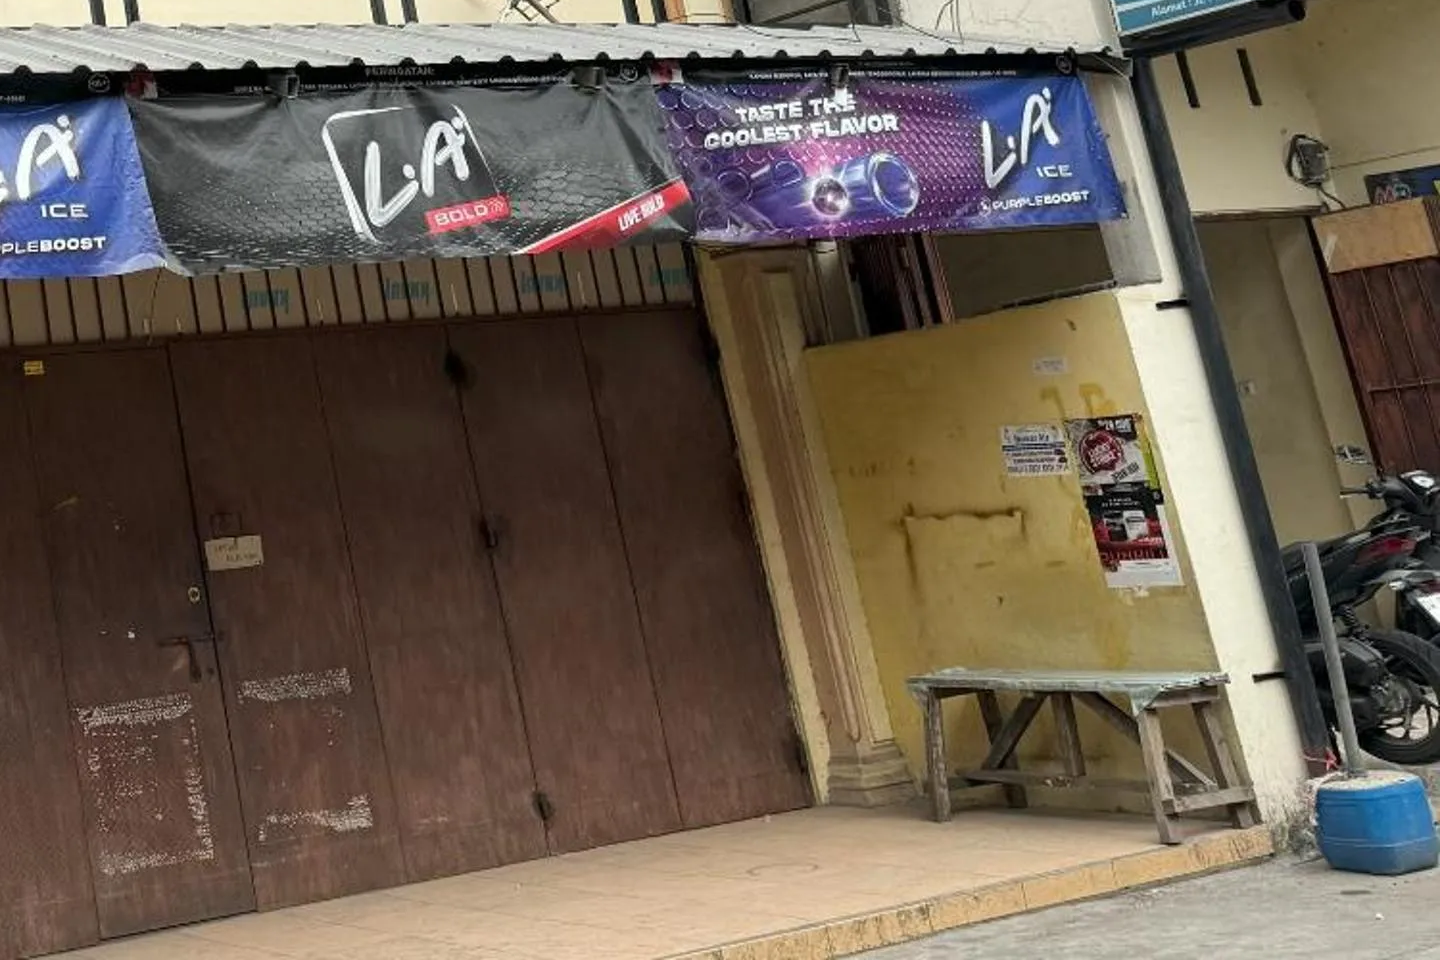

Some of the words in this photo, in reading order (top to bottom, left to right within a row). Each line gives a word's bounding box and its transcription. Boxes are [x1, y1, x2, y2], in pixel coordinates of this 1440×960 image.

[735, 101, 803, 123] TASTE
[809, 92, 857, 116] THE
[704, 124, 803, 150] COOLEST
[809, 113, 900, 139] FLAVOR
[1035, 164, 1073, 178] ICE
[40, 203, 89, 218] ICE
[992, 190, 1090, 210] PURPLEBOOST
[434, 204, 489, 226] BOLD
